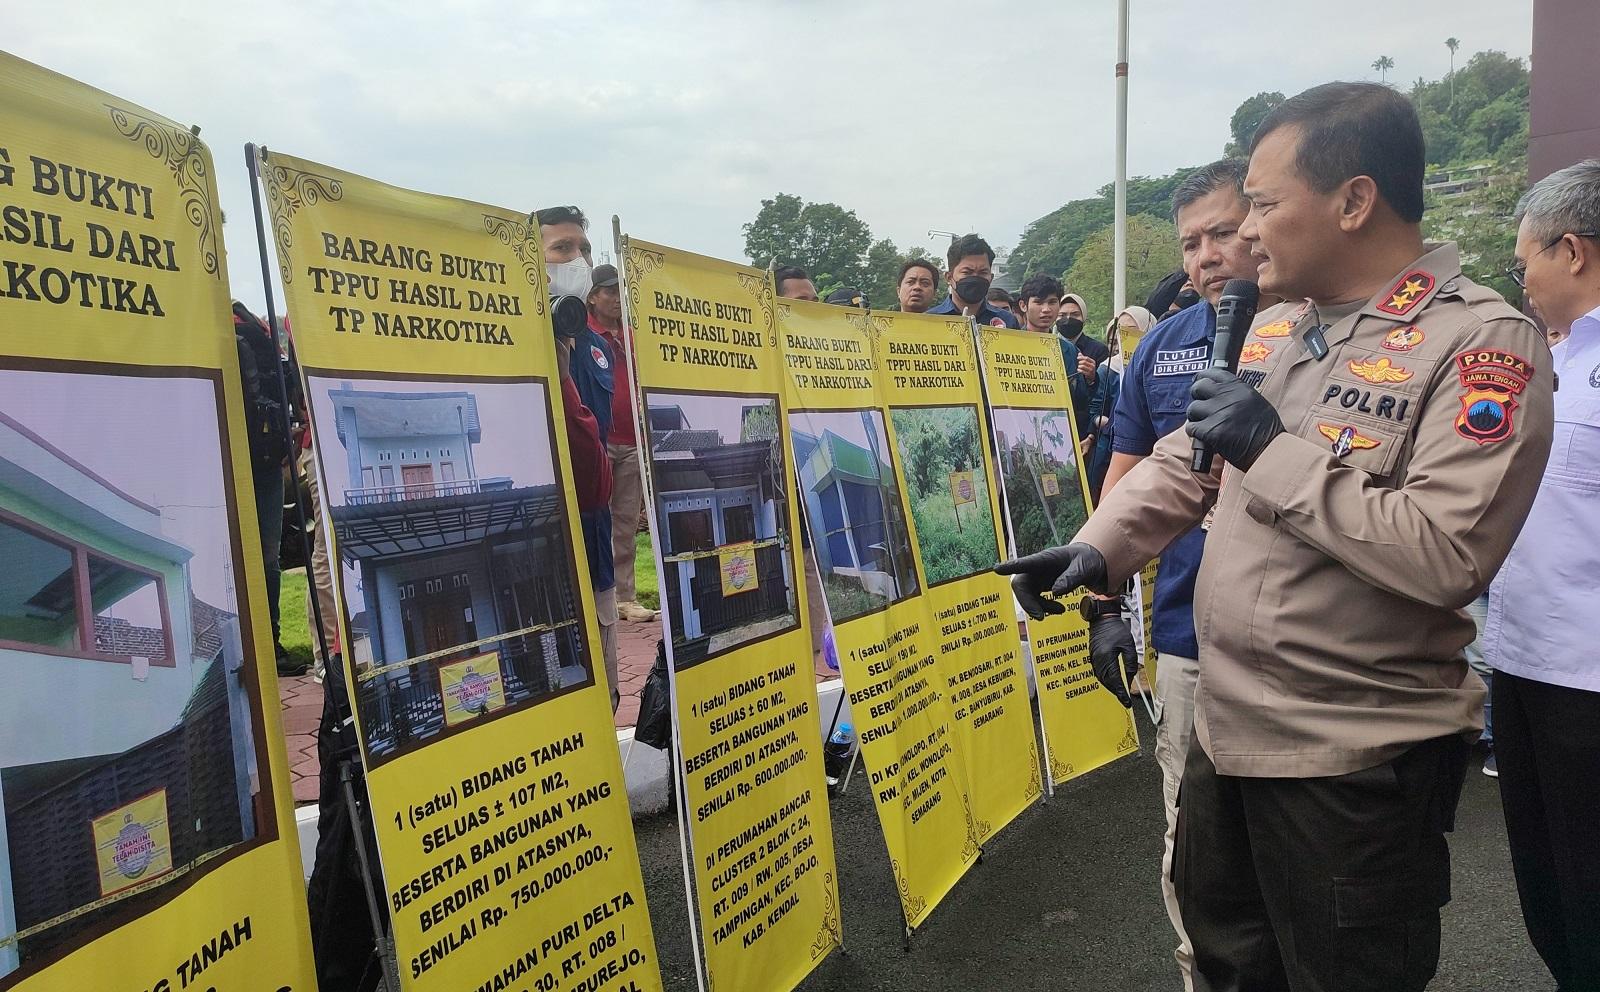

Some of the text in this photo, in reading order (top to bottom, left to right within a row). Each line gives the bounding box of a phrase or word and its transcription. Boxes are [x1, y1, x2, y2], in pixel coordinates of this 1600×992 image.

[30, 156, 154, 220] BUKTI
[0, 206, 180, 271] SIL DARI
[321, 232, 506, 284] BARANG BUKTI
[0, 261, 166, 316] KOTIKA
[308, 267, 522, 316] TPPU HASIL DARI
[654, 291, 752, 324] BARANG BUKTI
[329, 306, 514, 345] TP NARKOTIKA
[649, 316, 762, 347] TPPU HASIL DARI
[660, 343, 758, 369] TP NARKOTIKA
[786, 334, 861, 353] BARANG BUKTI
[889, 343, 959, 356] BARANG BUKTI
[995, 353, 1050, 367] BARANG BUKTI
[1164, 349, 1200, 360] LUTFI
[785, 354, 872, 370] TPPU HASIL DARI
[886, 359, 966, 372] TPPU HASIL DARI
[994, 367, 1056, 381] TPPU HASIL DARI
[1158, 363, 1203, 373] DIREKTUR
[1464, 353, 1526, 377] POLDA
[795, 375, 872, 389] TP NARKOTIKA
[894, 376, 964, 387] TP NARKOTIKA
[1000, 382, 1055, 394] TP NARKOTIKA
[1466, 374, 1520, 388] JAWA TENGAH
[1322, 384, 1409, 421] POLRI
[957, 599, 979, 614] BIDANG
[981, 593, 1000, 605] TANAH
[850, 651, 855, 661] 1
[859, 640, 887, 661] (satu)
[903, 623, 919, 641] TANAH
[942, 620, 966, 636] SELUAS
[1037, 629, 1085, 648] DI PERUMAHAN
[1036, 643, 1087, 664] BERINGIN INDAH
[1040, 668, 1052, 678] RW.
[1068, 660, 1081, 672] KEL.
[692, 663, 795, 718] 1 (satu) BIDANG TANAH
[850, 679, 893, 705] BESERTA
[1046, 681, 1061, 690] KEC.
[1066, 682, 1099, 699] SEMARANG
[710, 691, 786, 735] SELUAS ± 60 M2,
[974, 706, 1004, 729] SEMARANG
[685, 702, 809, 774] BESERTA BANGUNAN YANG
[704, 731, 799, 791] BERDIRI DI ATASNYA,
[872, 771, 883, 785] DI
[885, 762, 900, 778] KP.
[931, 767, 946, 785] KOTA
[394, 732, 584, 831] 1 (satu) BIDANG TANAH
[697, 749, 808, 822] SENILAI Rp. 600.000.000,-
[879, 786, 899, 803] RW.
[422, 771, 569, 854] SELUAS ± 107 M2,
[911, 791, 941, 824] SEMARANG
[706, 790, 811, 871] DI PERUMAHAN BANCAR
[133, 841, 156, 855] DISITA
[392, 782, 611, 913] BESERTA BANGUNAN YANG
[712, 814, 811, 892] CLUSTER 2 BLOK C 24,
[420, 823, 592, 933] BERDIRI DI ATASNYA,
[713, 899, 729, 919] RT.
[732, 882, 748, 905] 009
[756, 868, 773, 887] RW.
[775, 852, 791, 873] 005,
[793, 835, 814, 859] DESA
[411, 845, 613, 979] SENILAI Rp. 750.000.000,-
[713, 855, 818, 946] TAMPINGAN, KEC. BOJO,
[743, 892, 799, 949] KAB. KENDAL
[177, 916, 252, 989] TANAH
[474, 891, 634, 992] MAHAN PURI DELTA
[534, 972, 559, 992] 30,
[561, 951, 585, 978] RT.
[589, 931, 616, 959] 008
[571, 949, 645, 992] PUREJO,
